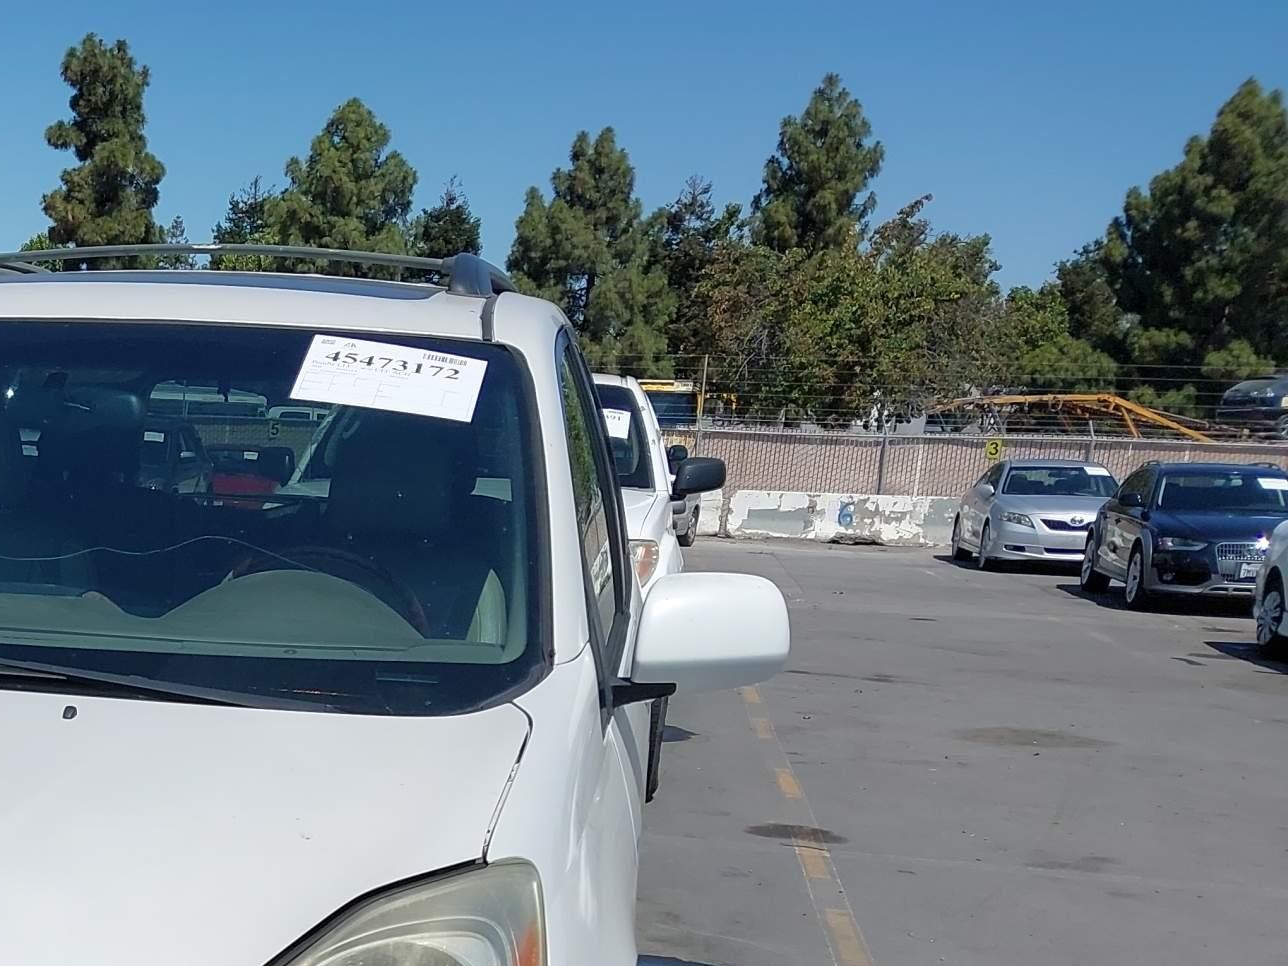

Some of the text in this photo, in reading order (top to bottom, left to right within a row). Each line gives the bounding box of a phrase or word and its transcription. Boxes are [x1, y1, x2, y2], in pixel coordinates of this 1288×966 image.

[324, 351, 460, 380] 45473172
[271, 423, 279, 436] 5
[988, 441, 999, 456] 3
